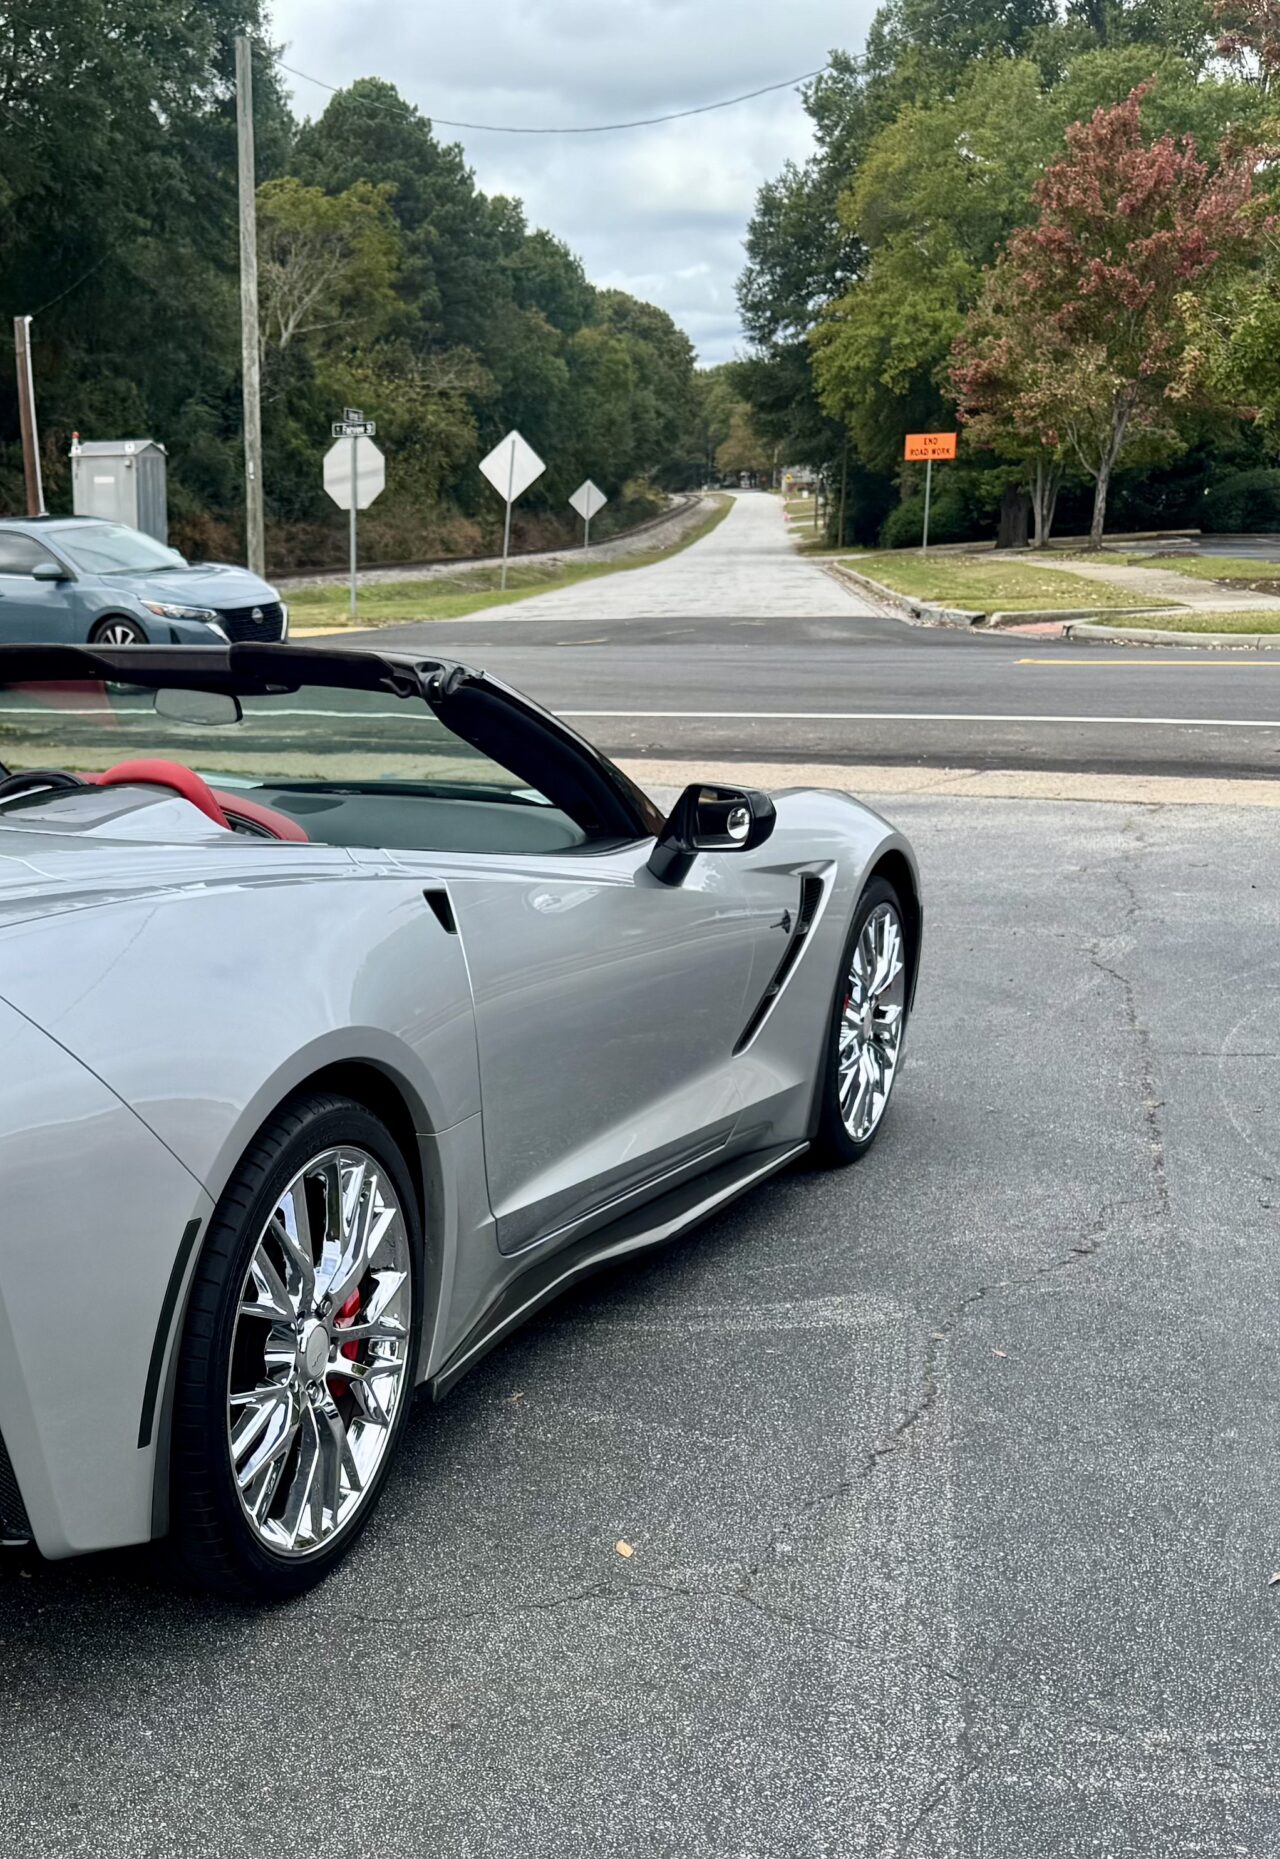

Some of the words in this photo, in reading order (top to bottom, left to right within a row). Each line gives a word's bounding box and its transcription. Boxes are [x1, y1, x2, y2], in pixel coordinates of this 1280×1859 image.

[923, 437, 938, 446] END
[910, 448, 929, 457] ROAD
[931, 447, 951, 456] WORK
